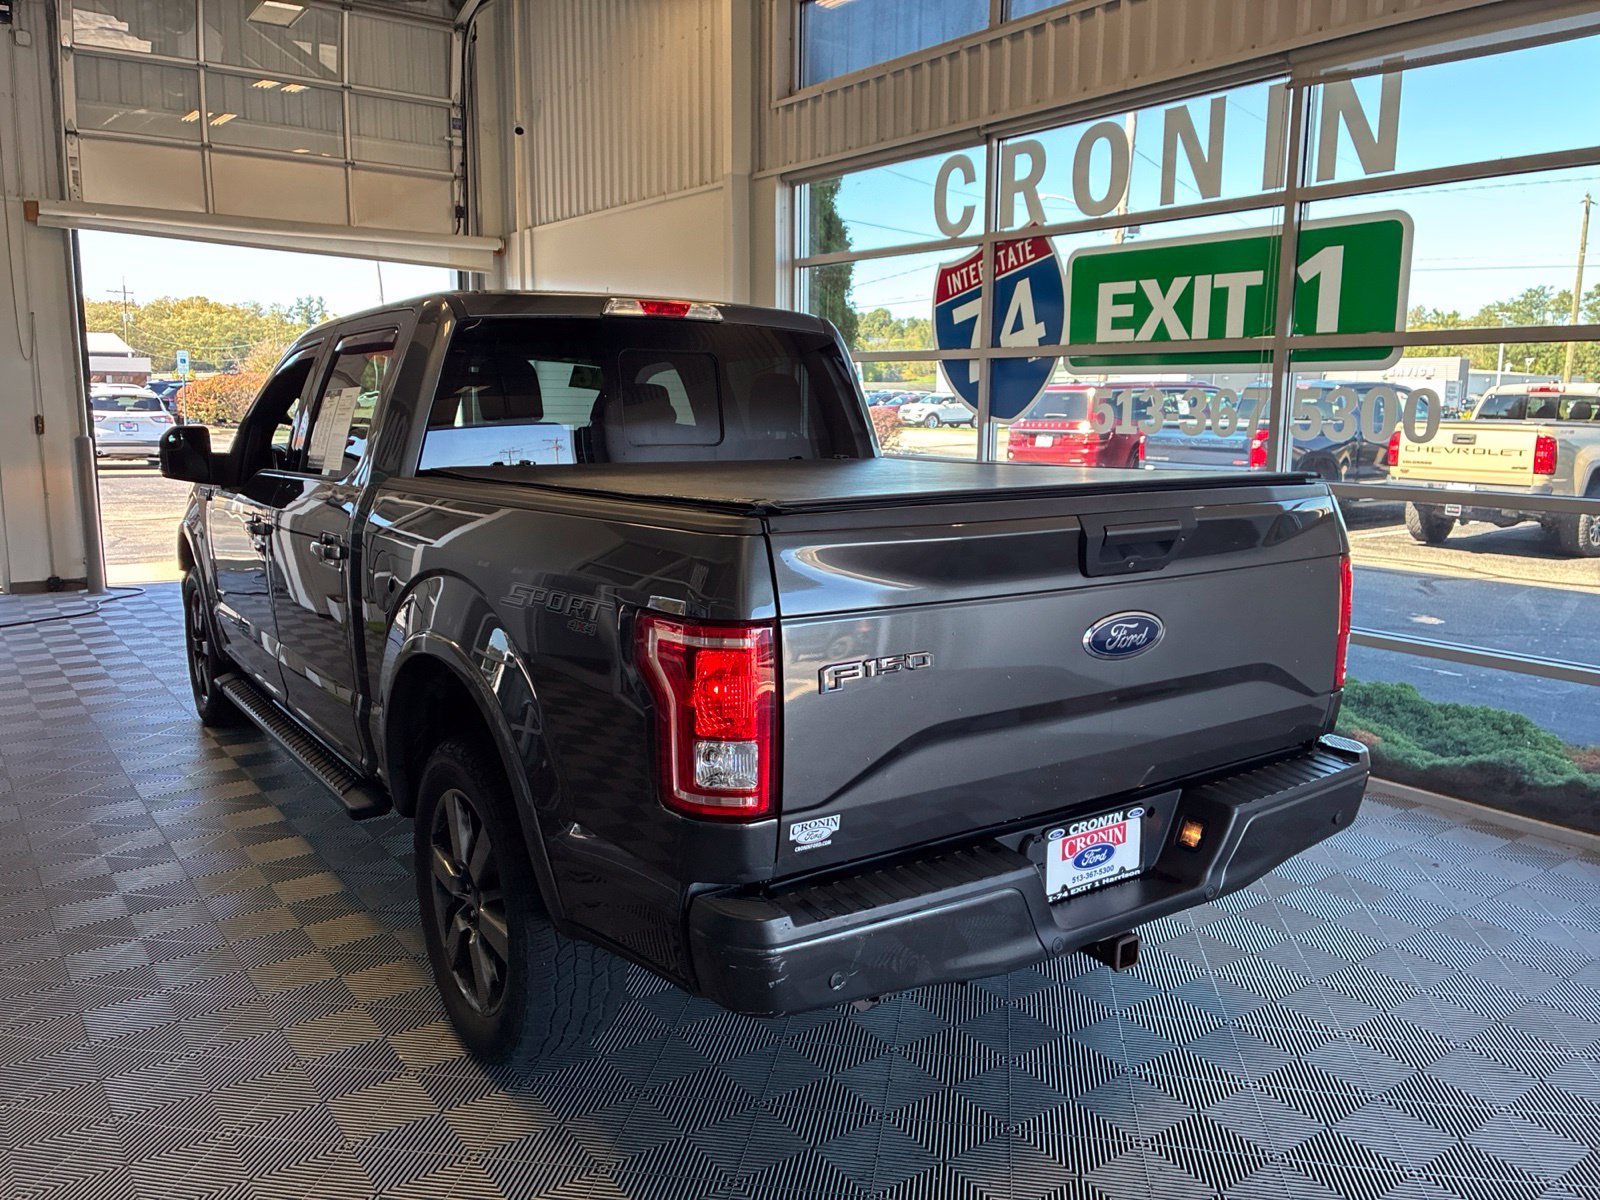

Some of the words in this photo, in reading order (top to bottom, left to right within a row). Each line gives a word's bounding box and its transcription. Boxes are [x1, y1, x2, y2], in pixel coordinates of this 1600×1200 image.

[934, 71, 1402, 237] CRONIN
[946, 239, 1036, 296] INTETATE
[1096, 270, 1264, 343] EXIT
[1296, 245, 1344, 333] 1
[1404, 444, 1527, 457] CHEVROLET
[500, 582, 616, 622] SPORT
[1105, 622, 1150, 651] Ford
[791, 816, 838, 836] CRONIN
[804, 829, 825, 841] Ford
[1069, 811, 1124, 835] CRONIN
[1064, 825, 1124, 859] CRONIN
[1081, 847, 1108, 866] Ford
[1047, 890, 1069, 903] I-74
[1070, 884, 1093, 896] EXIT
[1102, 869, 1141, 885] Harrison
[1071, 864, 1115, 884] 513-367-5300
